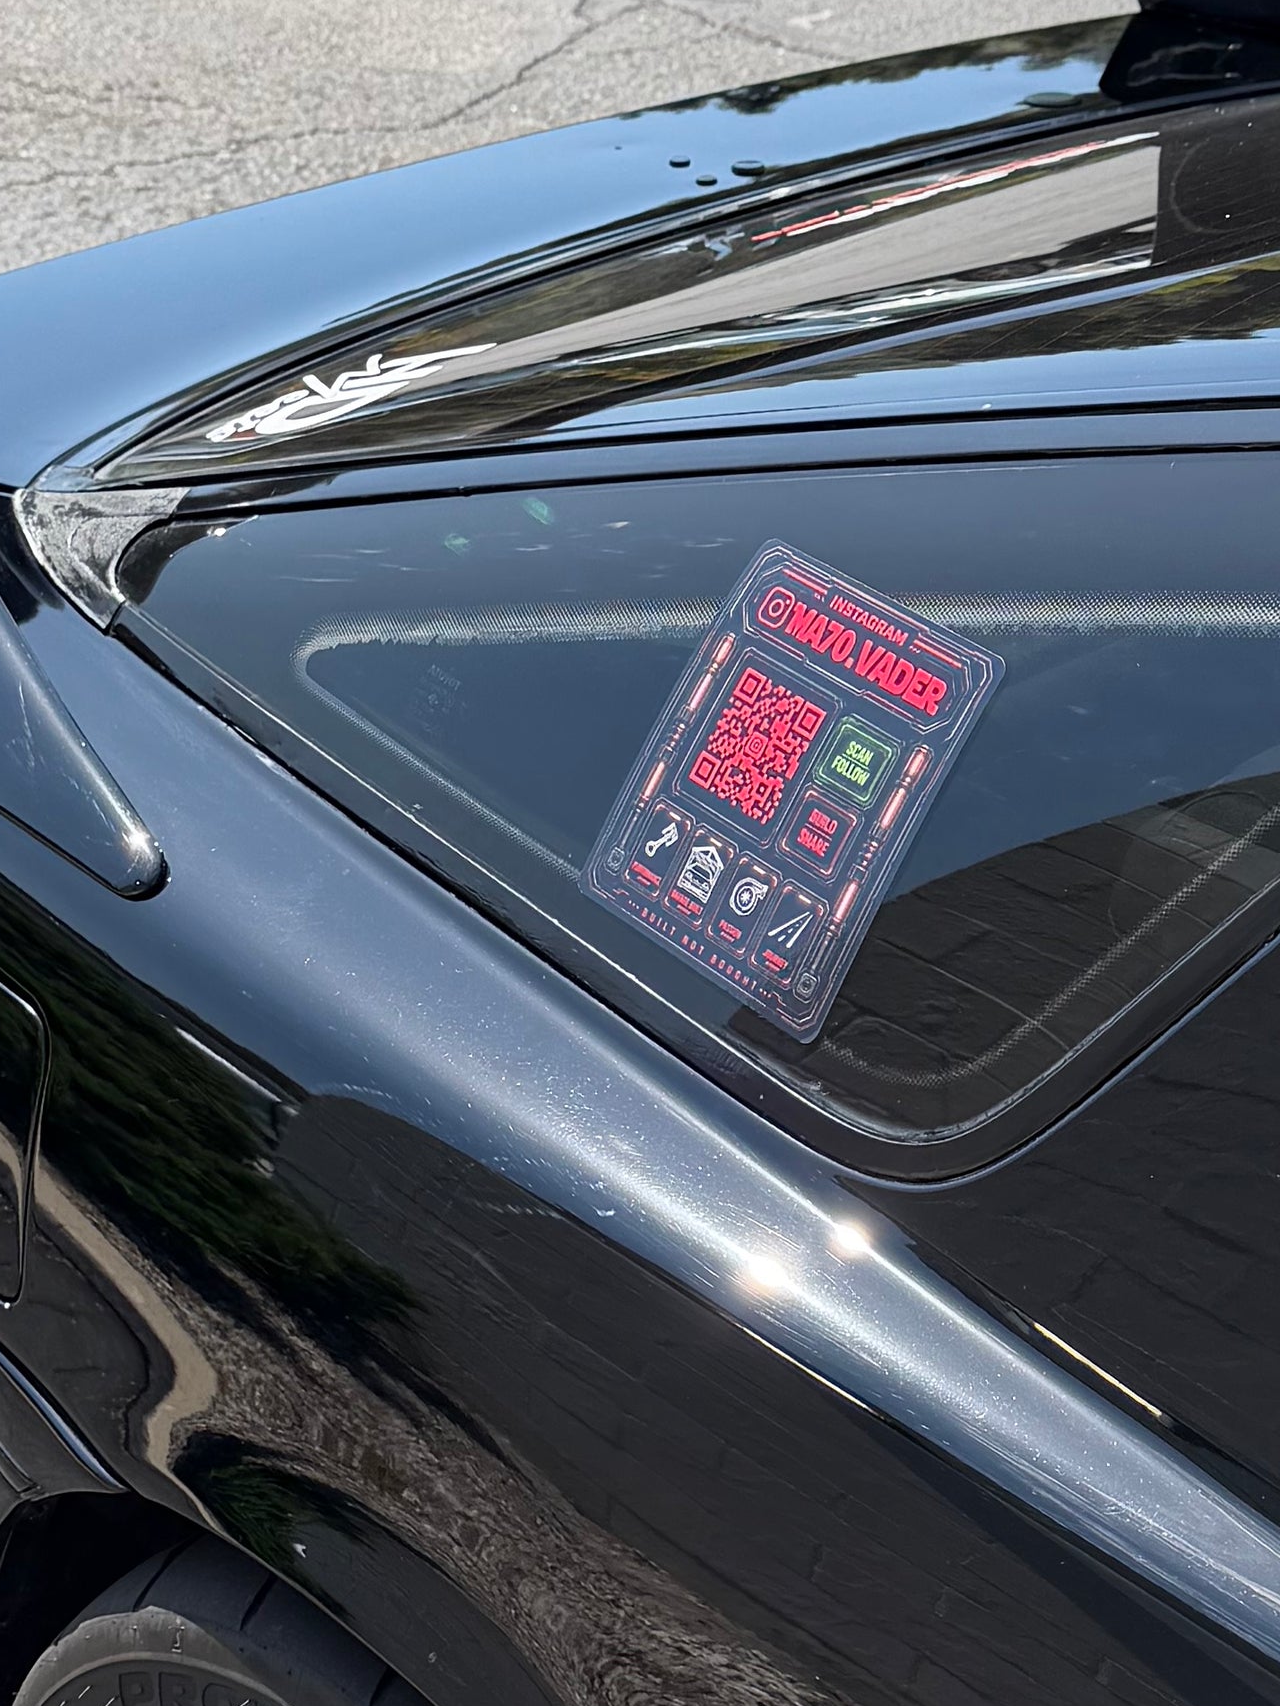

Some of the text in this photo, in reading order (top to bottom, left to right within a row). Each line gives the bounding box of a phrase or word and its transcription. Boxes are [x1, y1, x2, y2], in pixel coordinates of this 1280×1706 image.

[829, 594, 908, 647] INSTAGRAM
[784, 601, 948, 717] MA70.VADER
[831, 755, 870, 787] FOLLOW
[845, 740, 874, 766] SCAN
[797, 828, 830, 858] SHARE
[641, 907, 677, 936] BUILT
[681, 934, 705, 956] NOT
